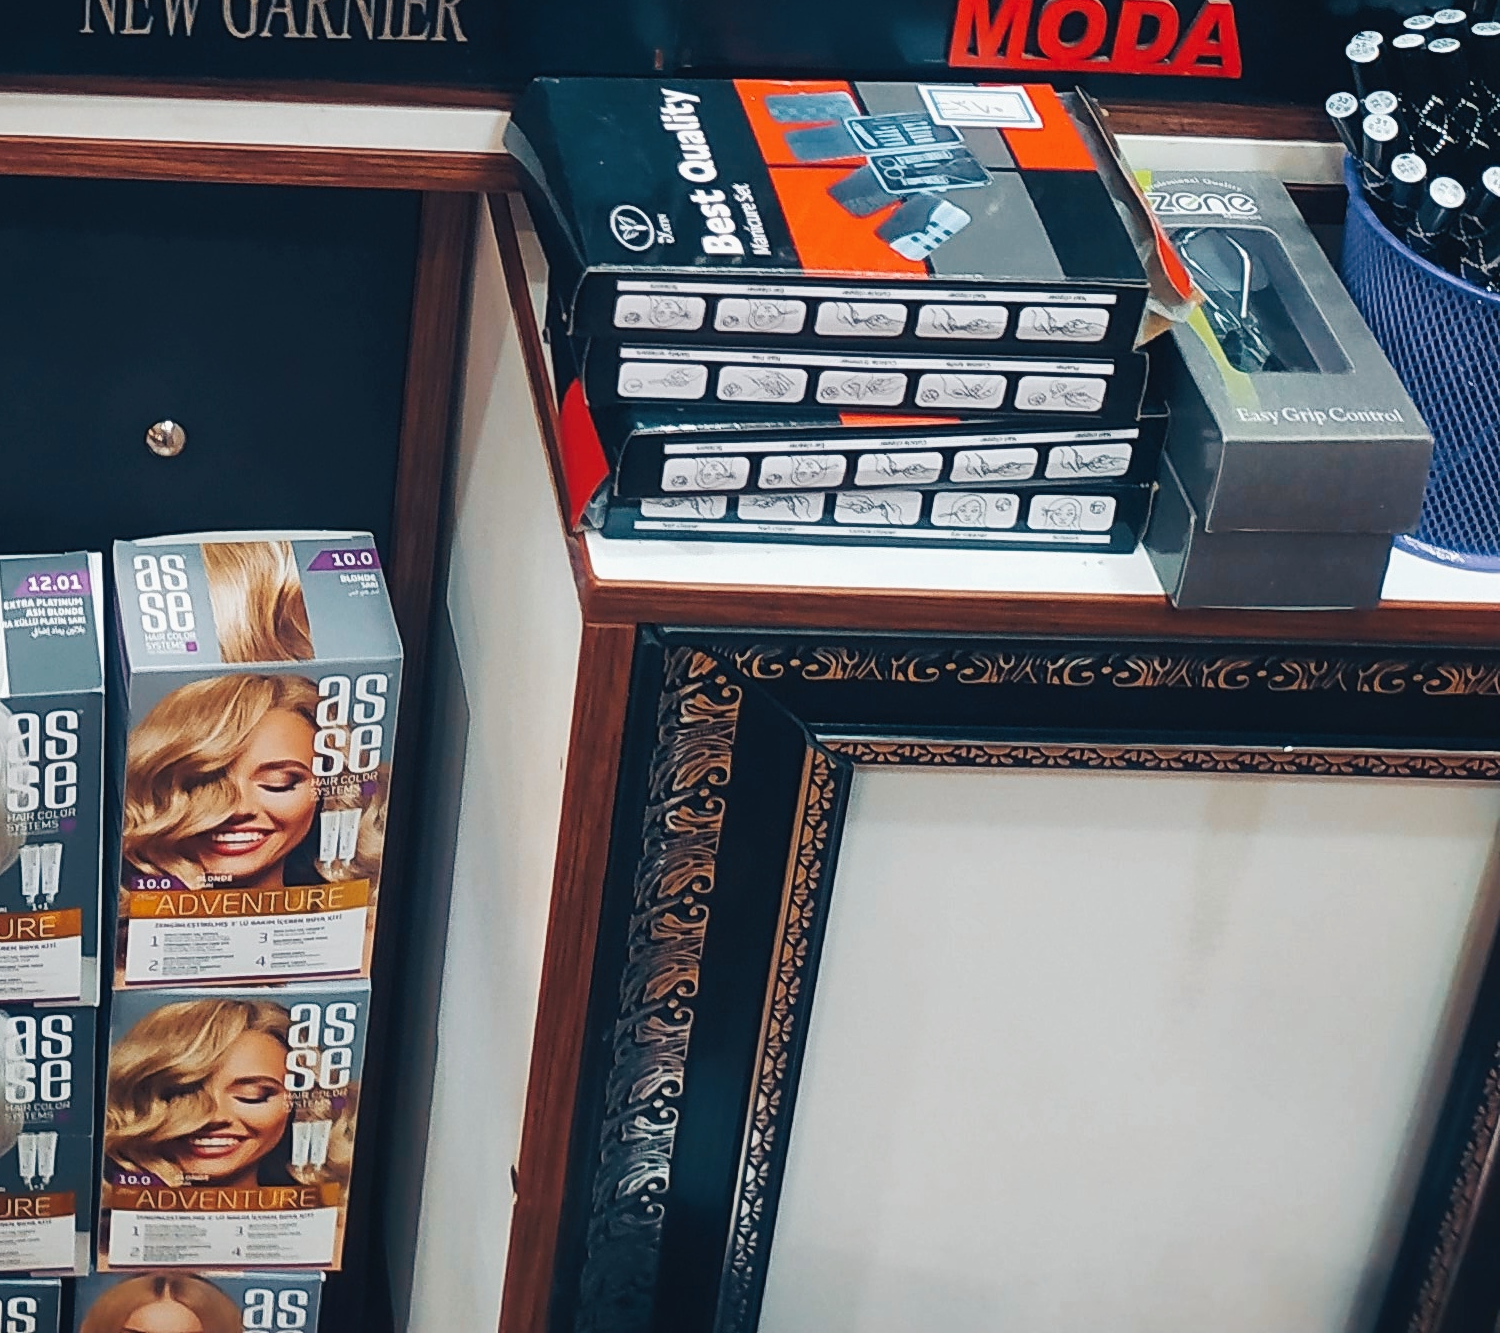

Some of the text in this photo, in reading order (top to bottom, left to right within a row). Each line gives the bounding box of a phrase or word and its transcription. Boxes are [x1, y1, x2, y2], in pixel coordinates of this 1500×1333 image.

[660, 87, 745, 256] Best Quality
[1236, 407, 1405, 426] Easy Grip Control
[331, 551, 374, 568] 10.0
[27, 574, 83, 592] 12.01
[36, 598, 84, 608] PLATINUM
[316, 675, 388, 725] as
[312, 725, 383, 776] se
[137, 878, 171, 890] 10.0
[155, 889, 345, 916] ADVENTURE
[134, 1187, 317, 1212] ADVENTURE
